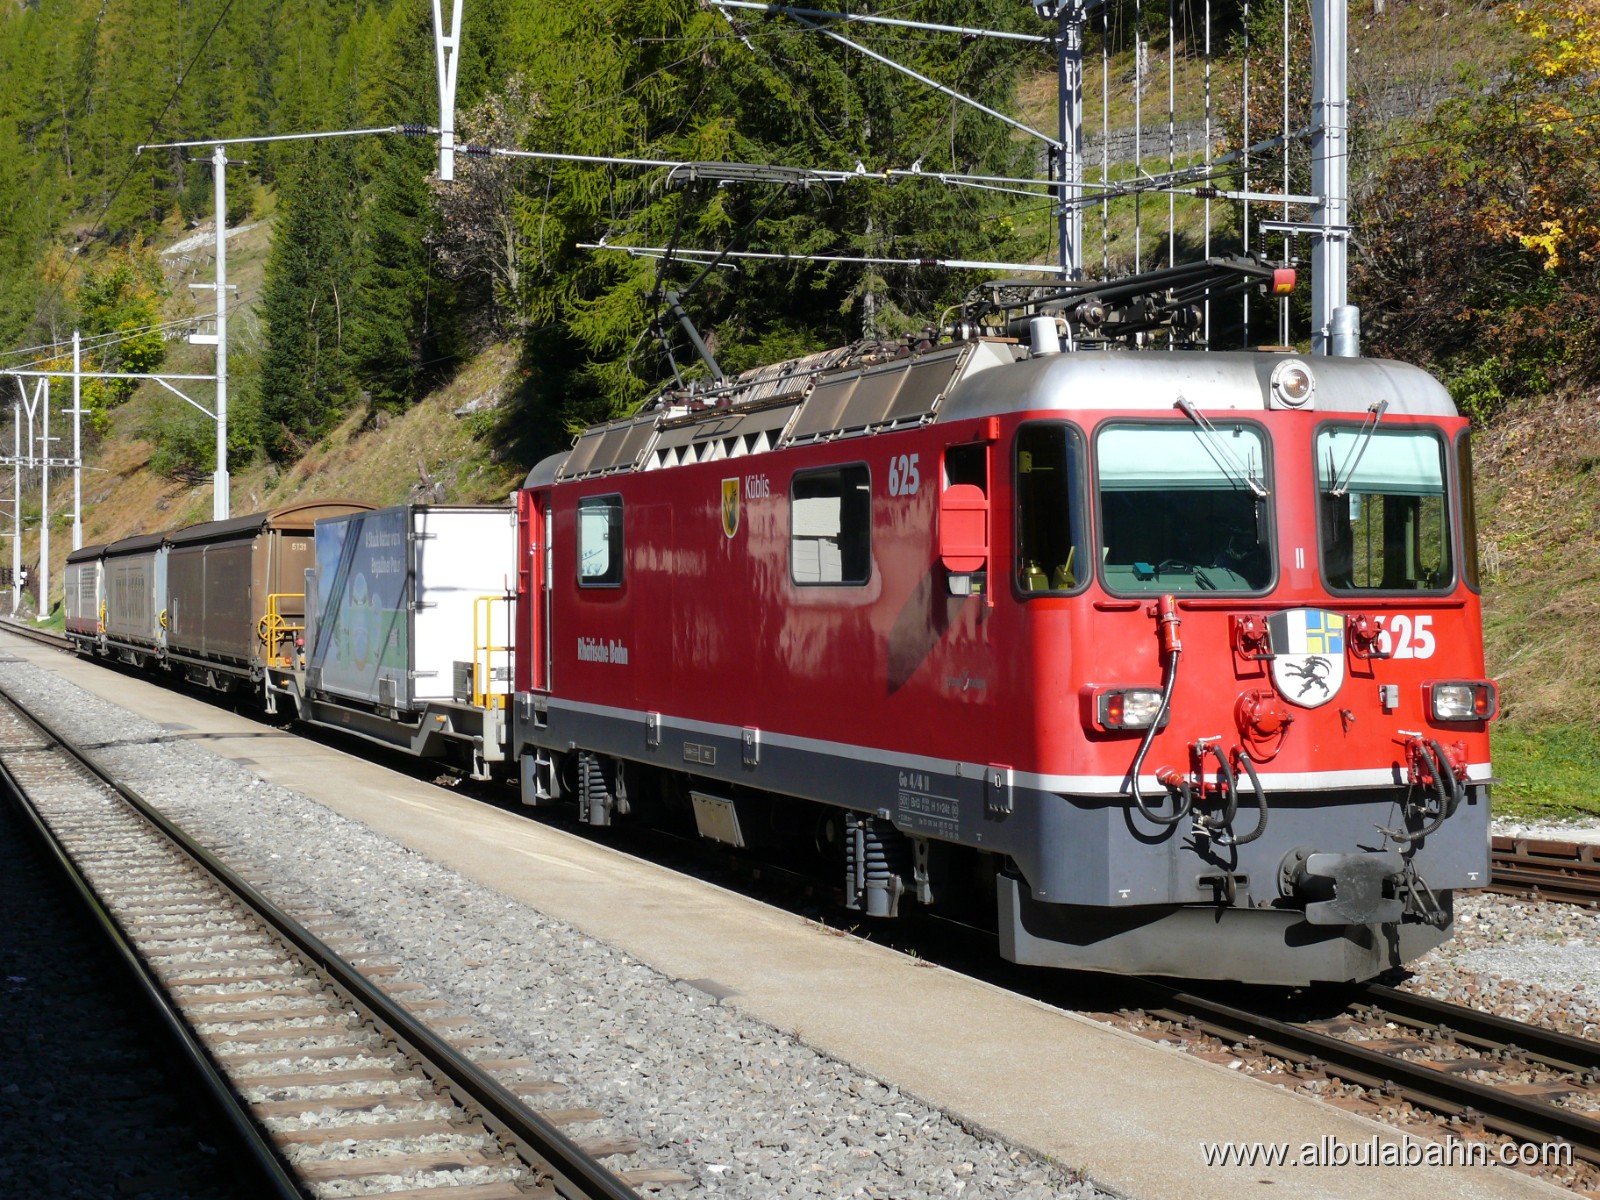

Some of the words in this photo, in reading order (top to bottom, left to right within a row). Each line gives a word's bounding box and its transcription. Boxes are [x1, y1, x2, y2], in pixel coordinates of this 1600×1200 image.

[745, 473, 770, 499] Küblis
[888, 453, 920, 497] 625
[291, 542, 307, 551] 5131
[577, 636, 609, 663] Rhätische
[609, 638, 628, 665] Bahn
[1369, 614, 1436, 660] 625
[909, 772, 923, 791] 4/4
